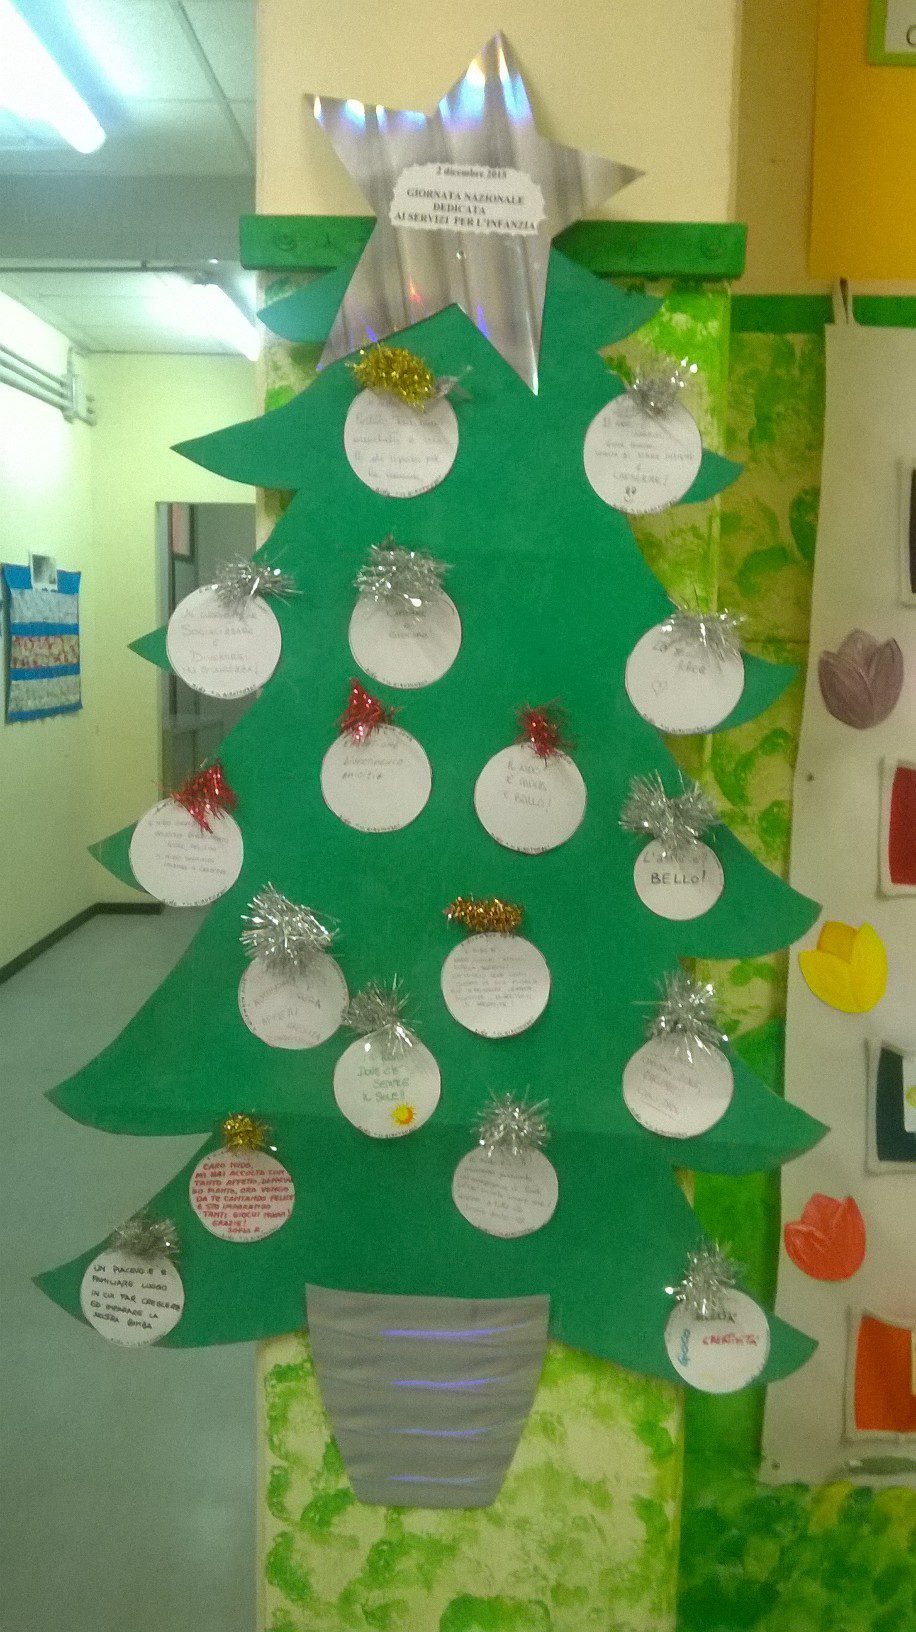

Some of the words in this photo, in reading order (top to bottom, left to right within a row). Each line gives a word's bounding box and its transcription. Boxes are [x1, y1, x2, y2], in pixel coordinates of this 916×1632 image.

[444, 166, 484, 179] dicembre
[406, 188, 461, 202] GIORNATA
[464, 192, 524, 205] NAZIONALE
[433, 202, 486, 215] DEDICATA
[408, 213, 449, 224] SERVIZI
[454, 216, 475, 227] PER
[476, 218, 536, 230] L'INFANZIA
[650, 869, 706, 885] BELLO!
[203, 1162, 226, 1170] CARO
[92, 1275, 134, 1288] FAMILIARE
[120, 1293, 137, 1303] FAR
